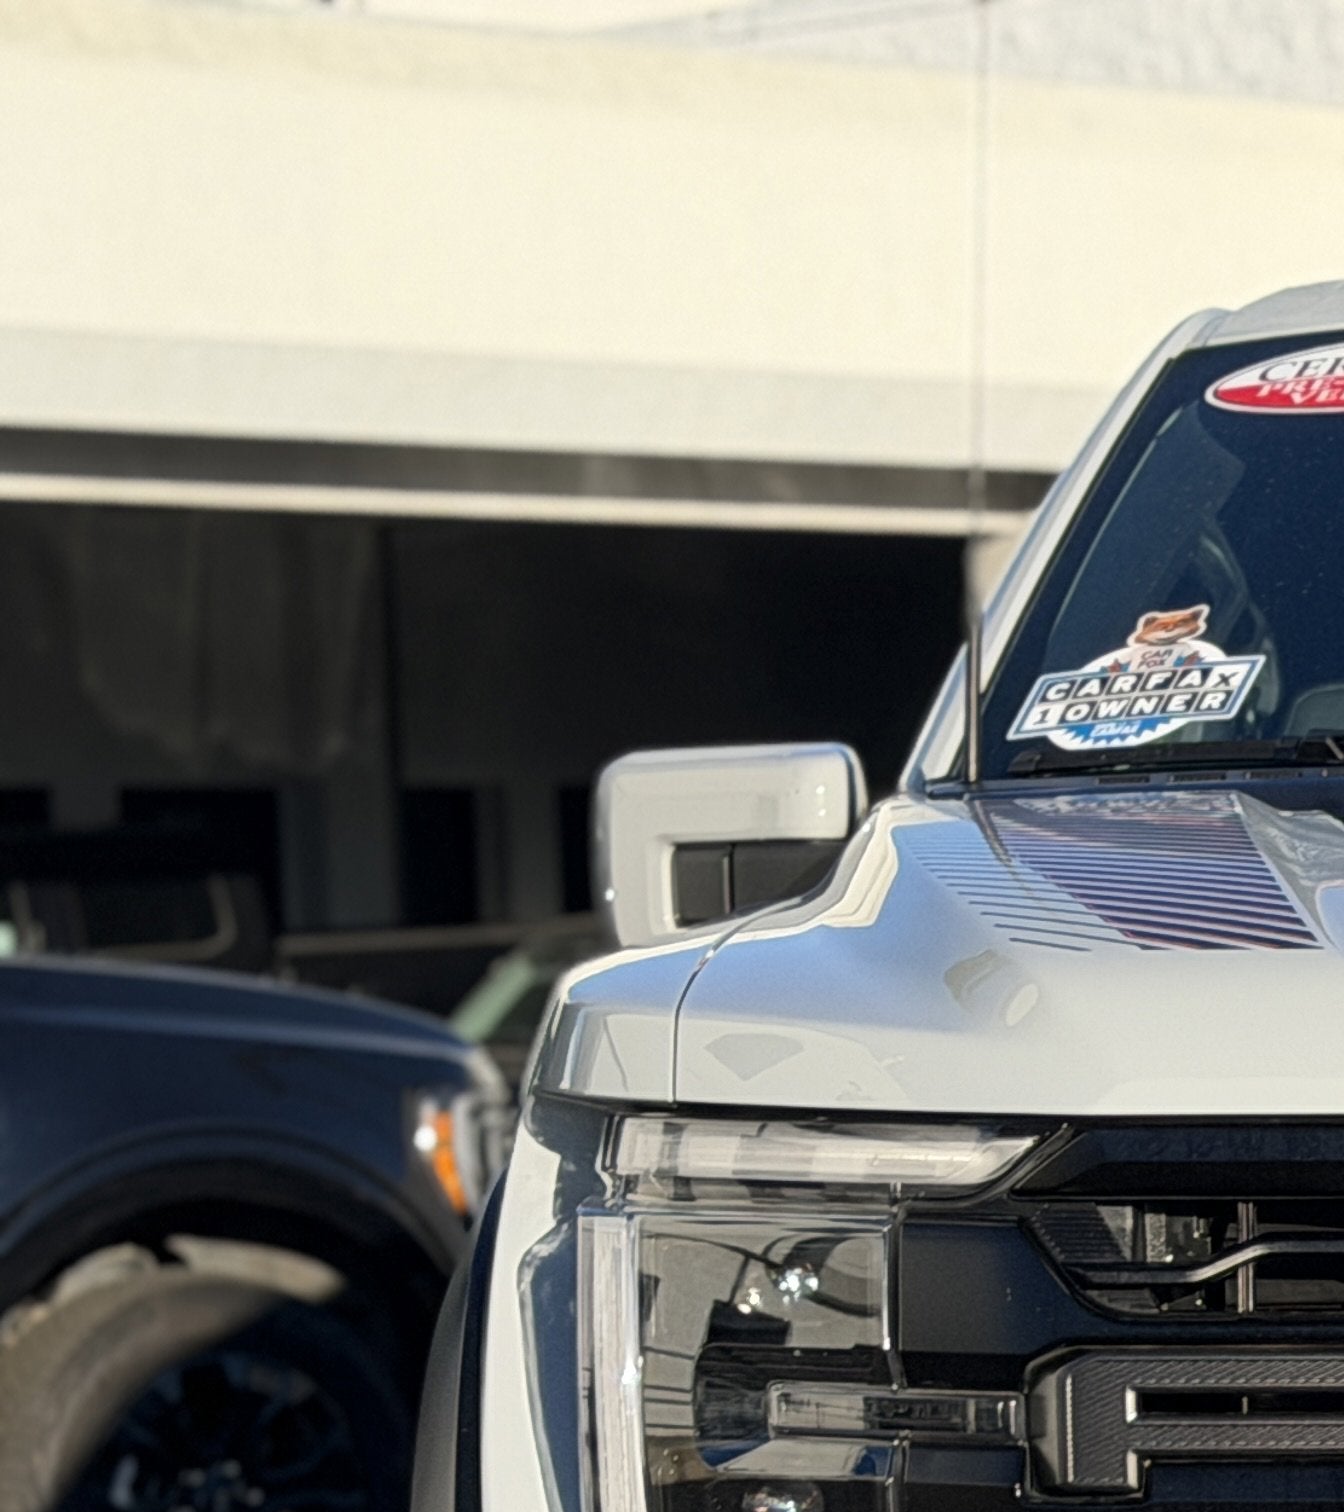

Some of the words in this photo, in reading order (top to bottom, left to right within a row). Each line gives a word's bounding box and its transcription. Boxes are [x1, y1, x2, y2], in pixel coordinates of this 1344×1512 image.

[1045, 670, 1239, 700] CARFAX
[1032, 704, 1053, 726] 1
[1064, 692, 1228, 722] OWNER
